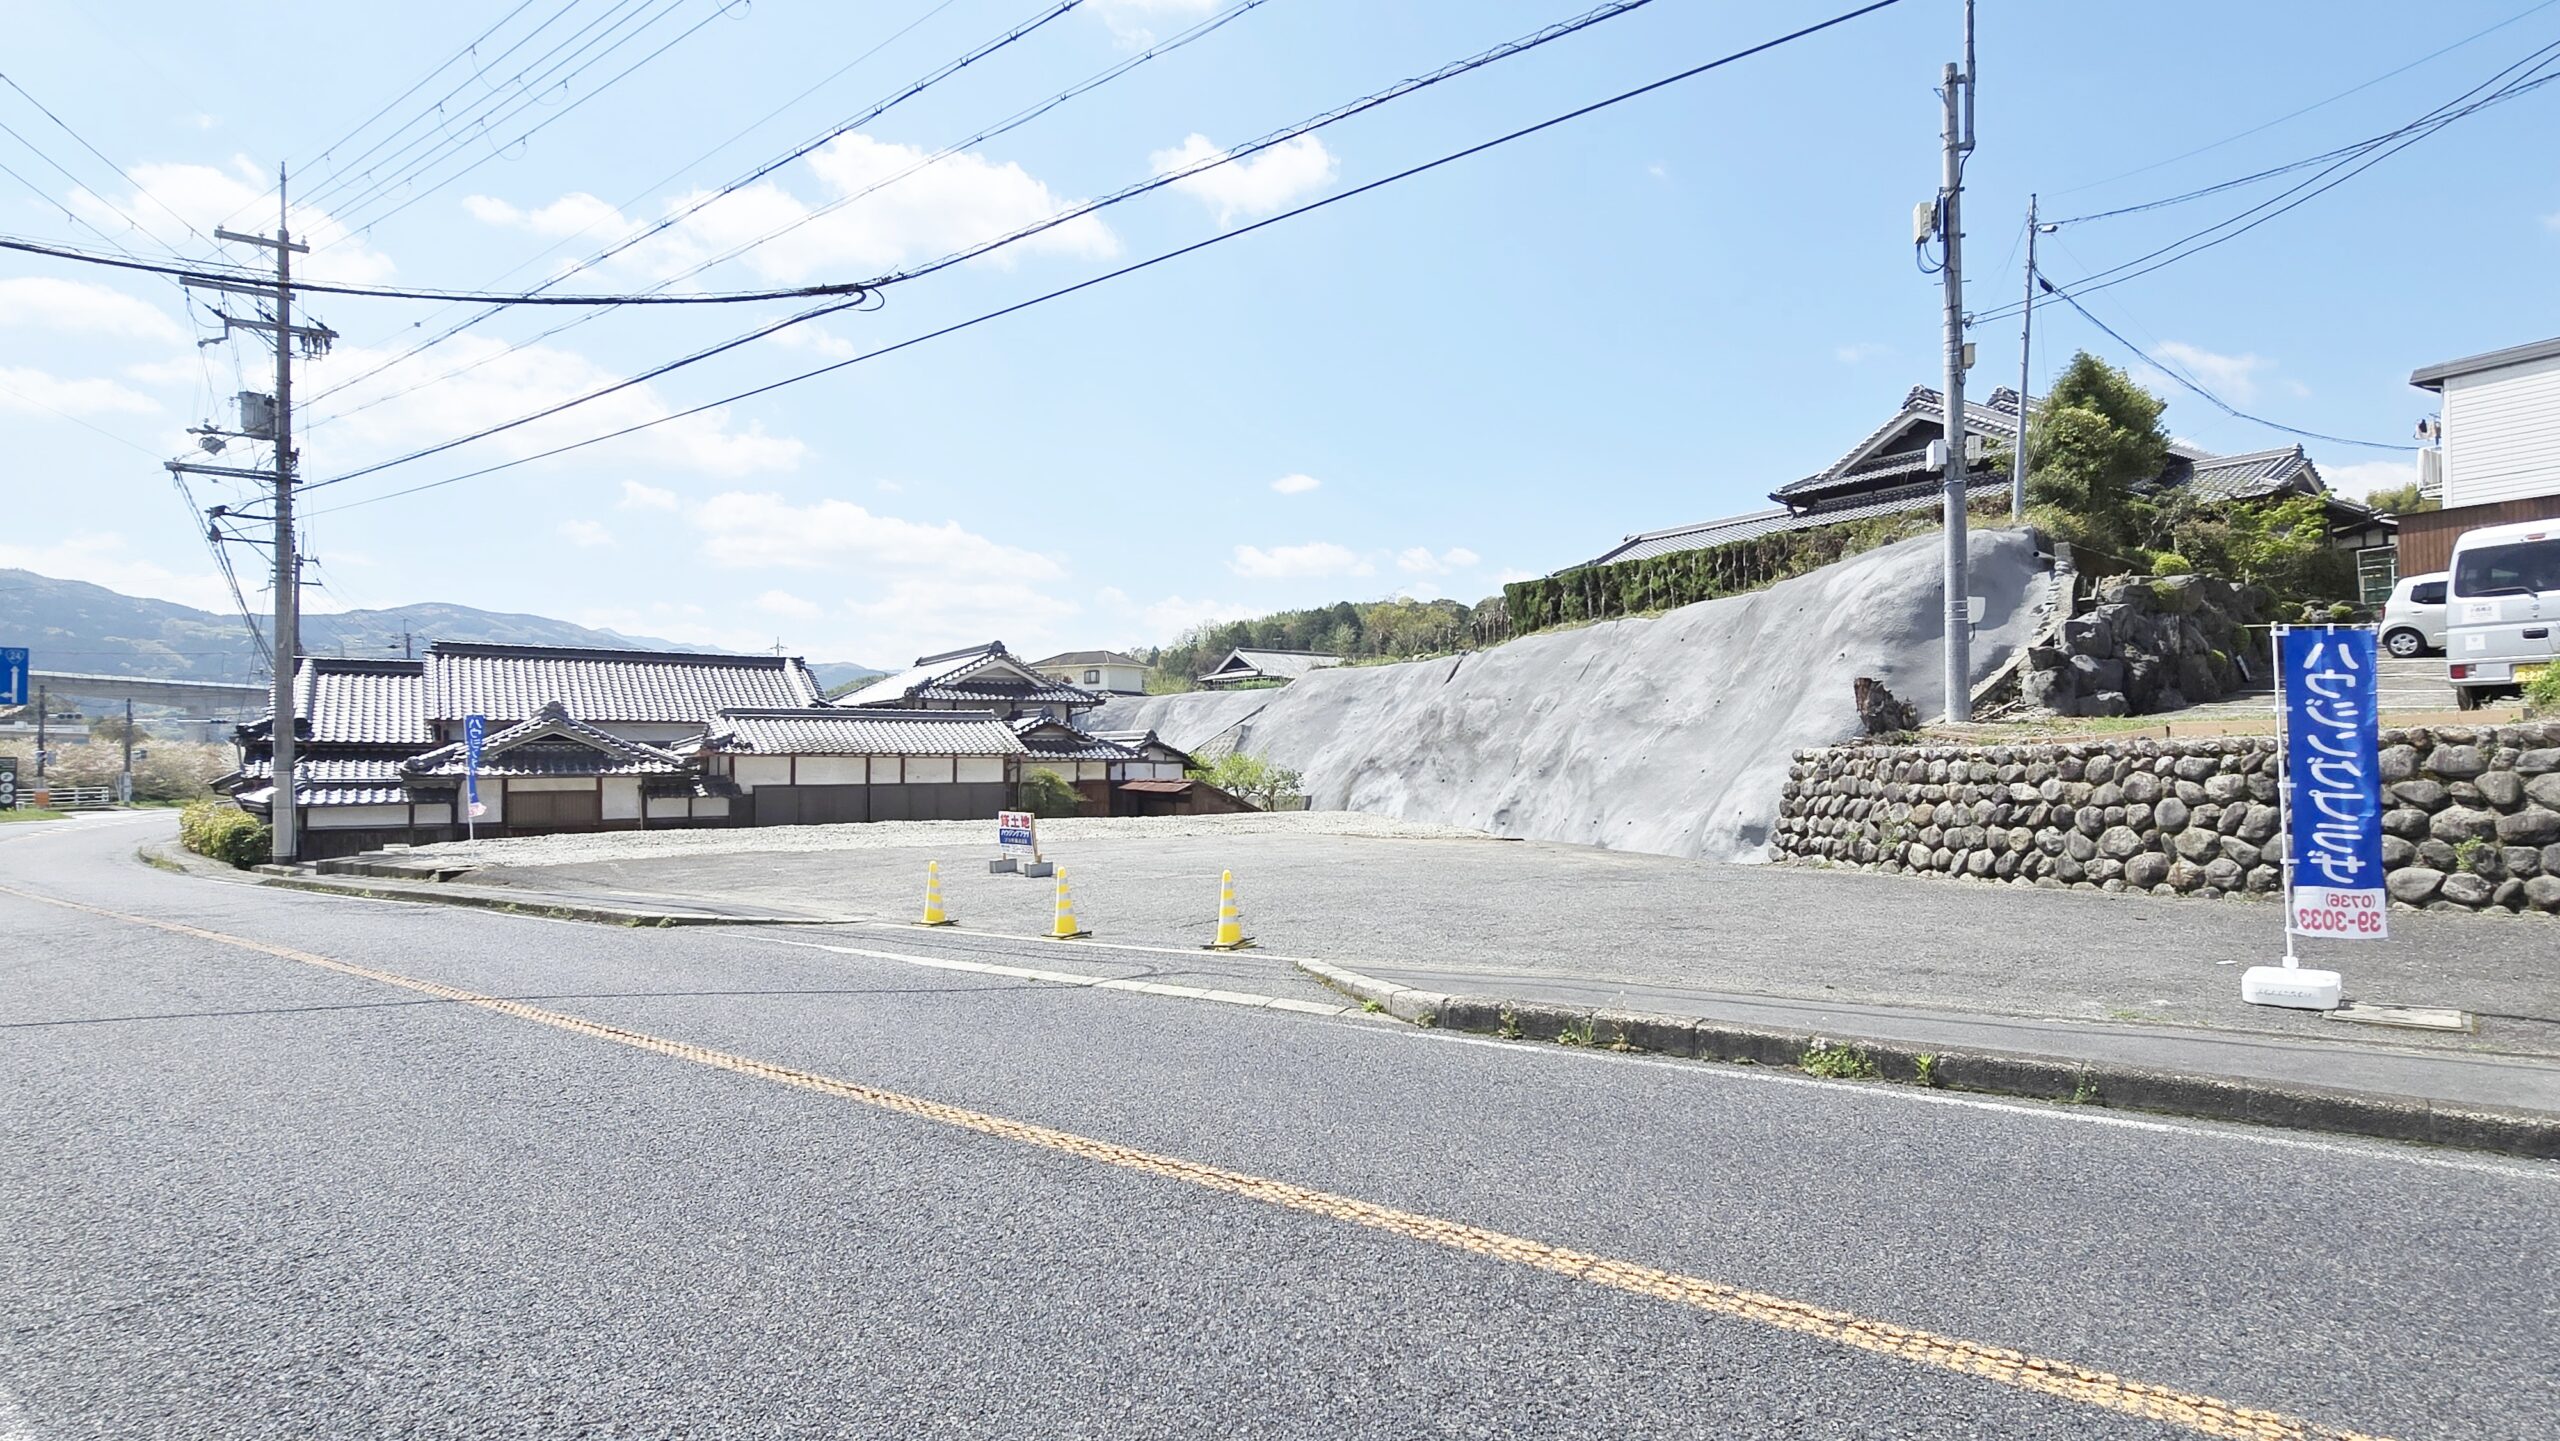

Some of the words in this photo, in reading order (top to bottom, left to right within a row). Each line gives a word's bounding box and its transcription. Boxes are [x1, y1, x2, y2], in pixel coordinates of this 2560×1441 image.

[10, 651, 21, 660] 24
[1000, 814, 1030, 828] 貸土地
